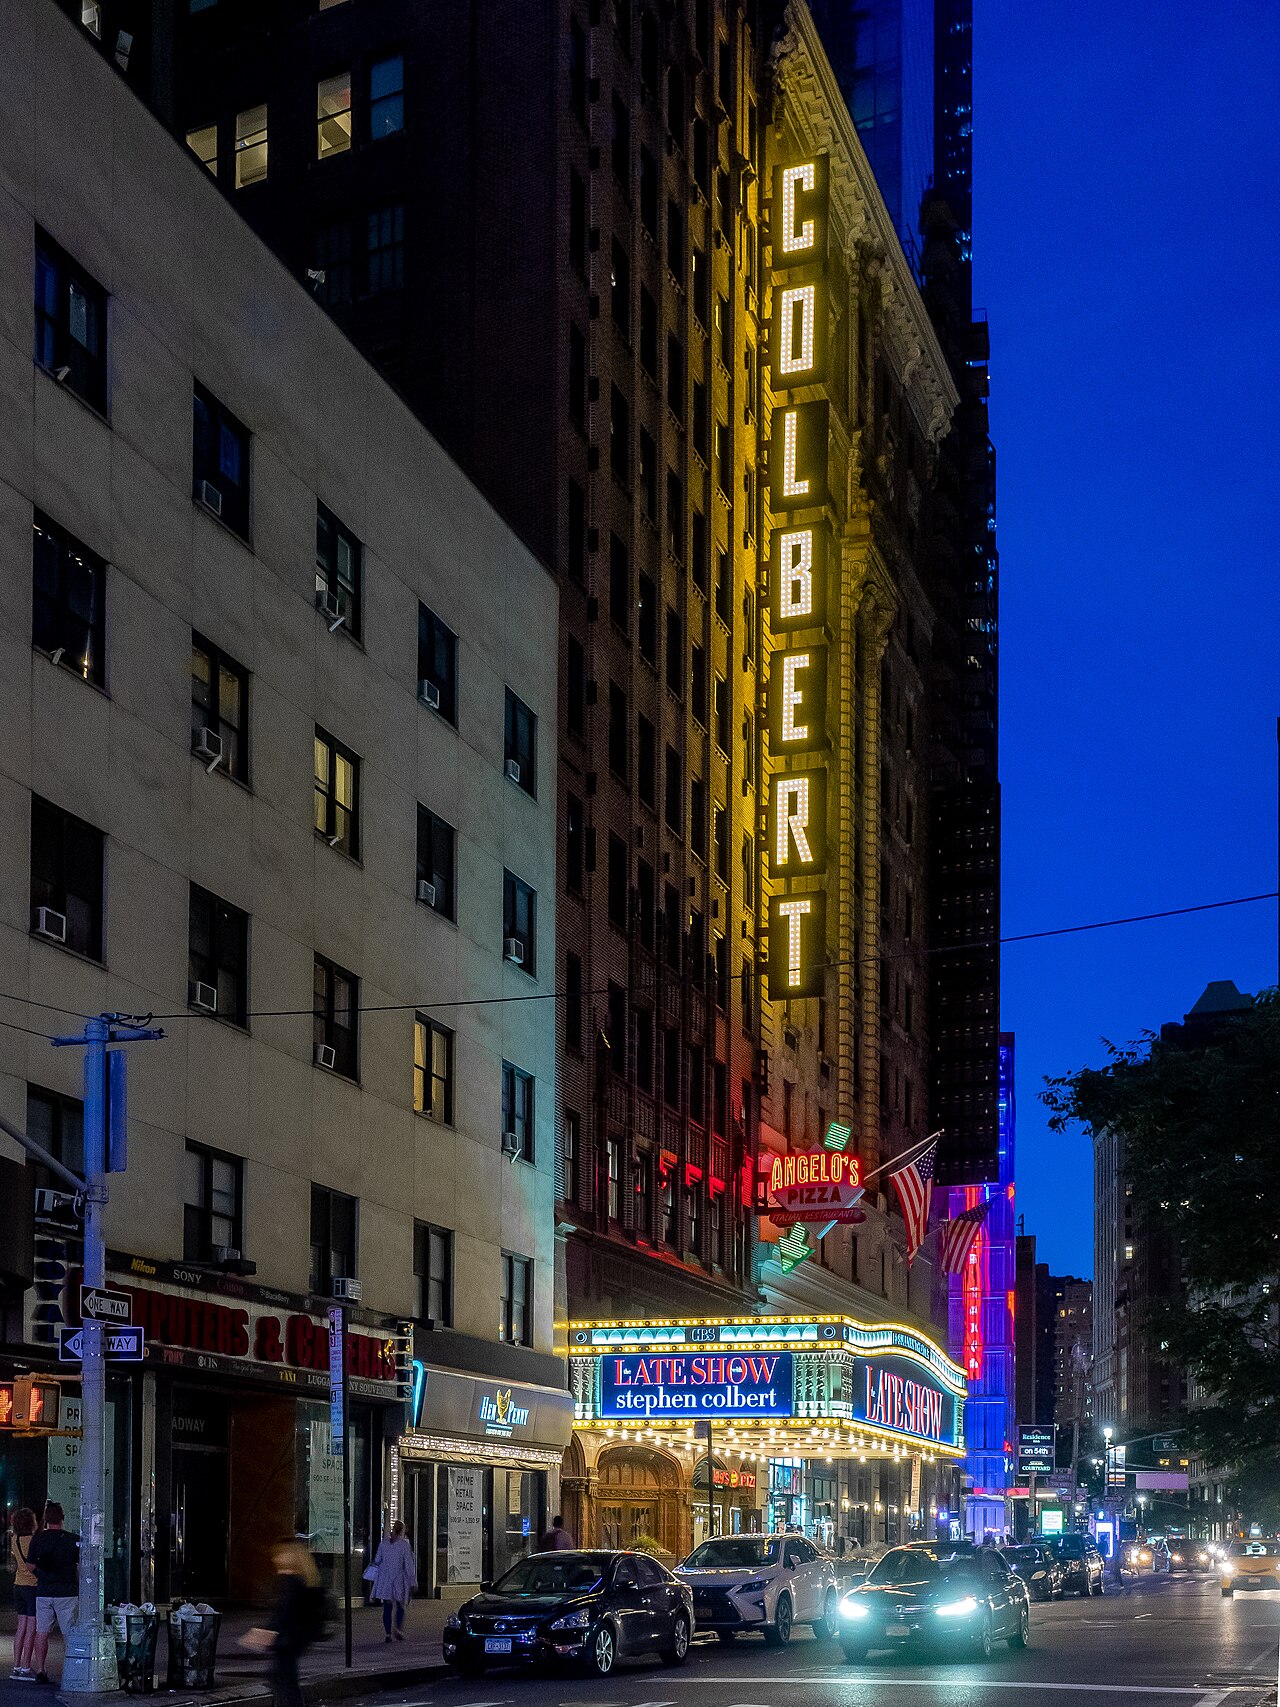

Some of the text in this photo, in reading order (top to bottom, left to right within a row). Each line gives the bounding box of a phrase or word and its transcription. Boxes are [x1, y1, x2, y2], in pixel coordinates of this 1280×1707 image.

[776, 163, 816, 988] COLBERT
[770, 1153, 860, 1191] ANGELO'S
[788, 1186, 842, 1204] PIZZA
[805, 1209, 854, 1220] RESTAURANT
[130, 1258, 157, 1275] Nikon
[173, 1269, 202, 1284] SONY
[88, 1297, 126, 1316] ONE WAY
[106, 1337, 131, 1350] WAY
[254, 1316, 284, 1363] &
[286, 1314, 397, 1381] CAERAS
[279, 1370, 297, 1383] TAXI
[614, 1357, 779, 1386] LATE SHOW
[307, 1374, 331, 1387] LUGGA
[616, 1385, 777, 1416] stephen colbert
[865, 1364, 944, 1440] LATE SHOW
[66, 1407, 83, 1420] PRI
[171, 1416, 206, 1433] ADWAY
[1034, 1446, 1049, 1455] 54th
[52, 1465, 66, 1475] 600
[67, 1467, 77, 1475] SF
[456, 1475, 474, 1486] PRIME
[455, 1488, 474, 1499] RETAIL
[456, 1501, 474, 1512] SPACE
